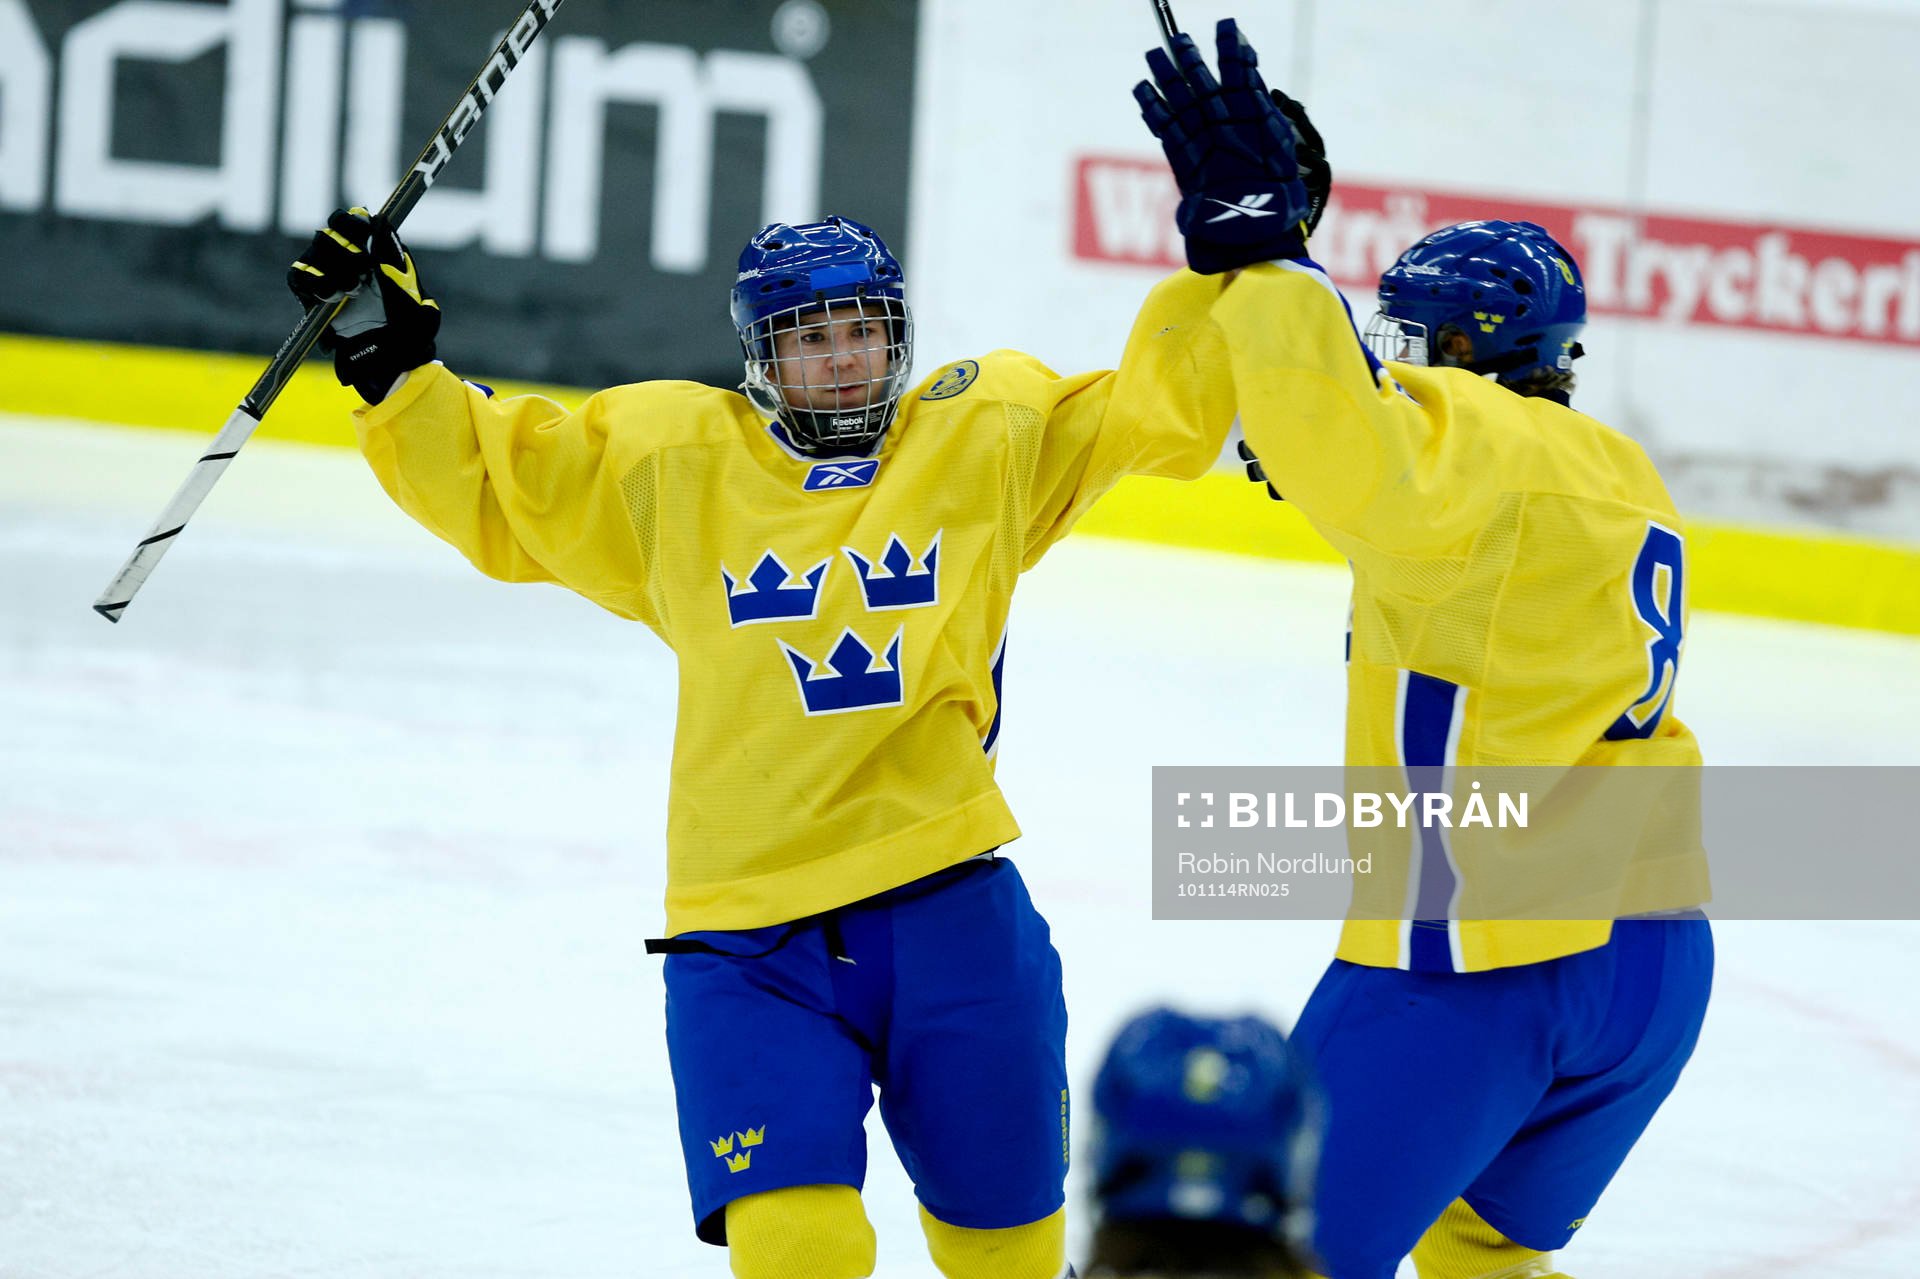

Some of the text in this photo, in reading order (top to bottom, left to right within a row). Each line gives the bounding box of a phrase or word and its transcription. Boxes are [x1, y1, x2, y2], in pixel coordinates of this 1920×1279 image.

[1556, 258, 1575, 286] 8
[832, 416, 864, 427] Reebok
[1601, 519, 1686, 741] 8
